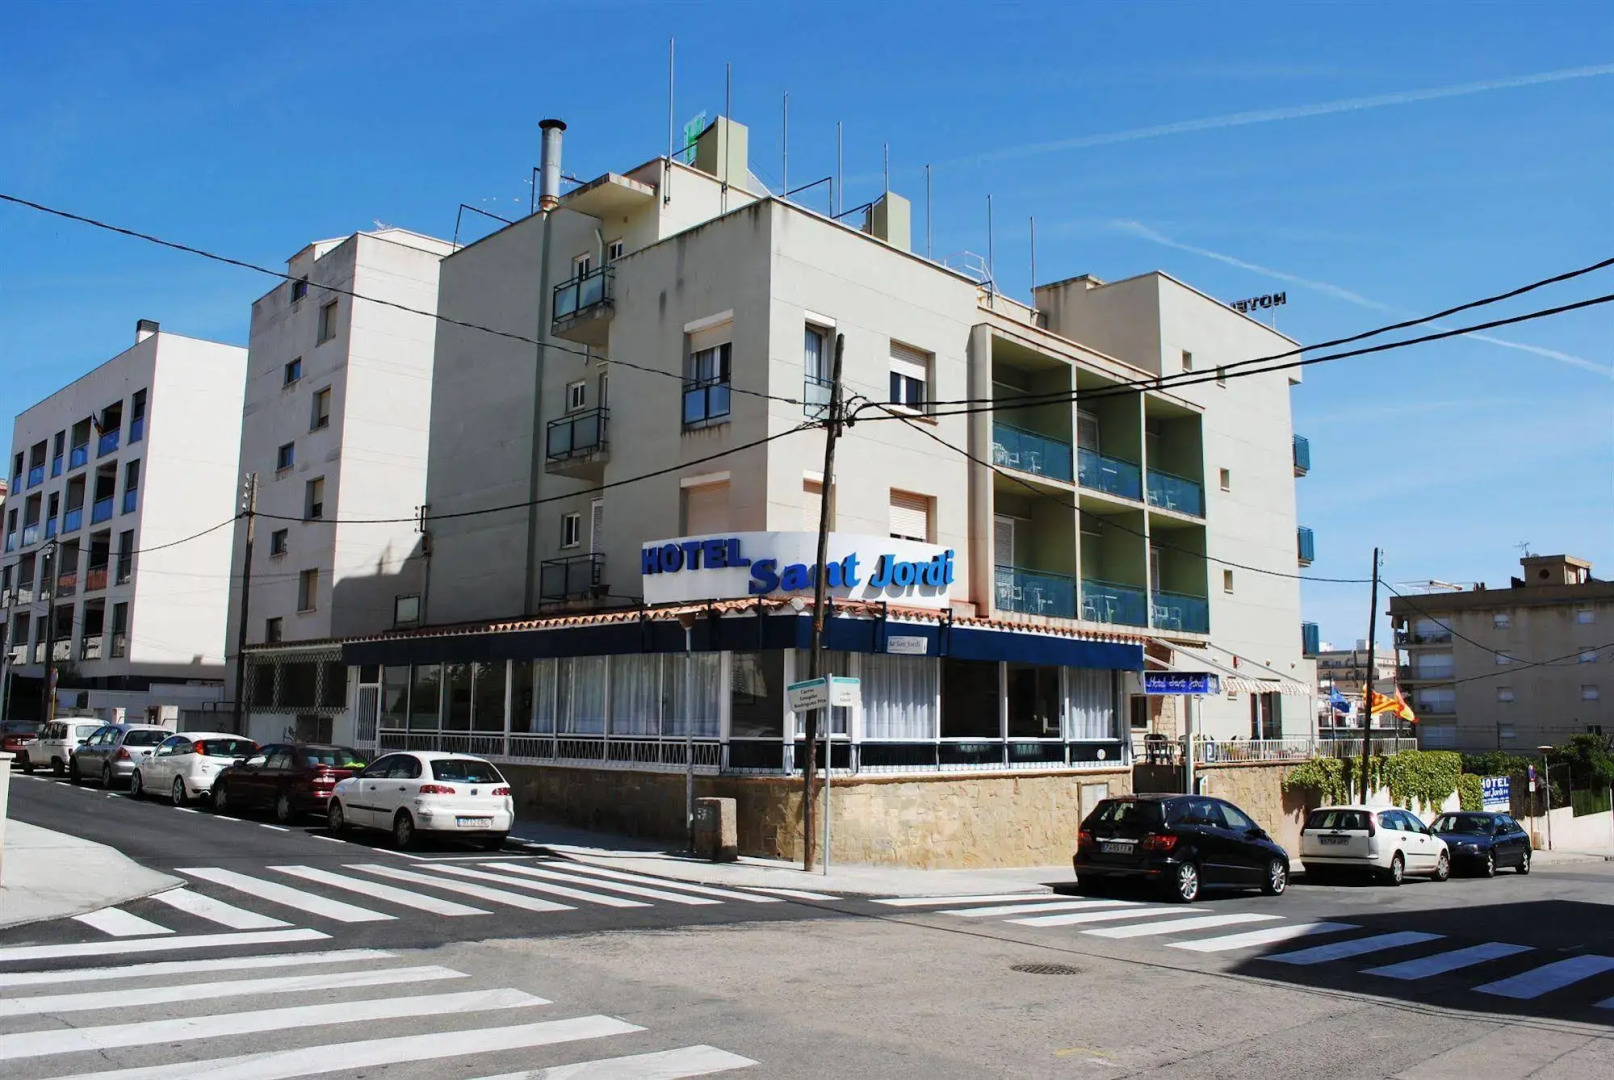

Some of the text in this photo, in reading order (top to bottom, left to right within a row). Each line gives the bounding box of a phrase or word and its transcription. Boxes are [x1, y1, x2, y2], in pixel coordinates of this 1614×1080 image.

[641, 538, 751, 574] HOTEL
[748, 549, 955, 595] Sant Jordi
